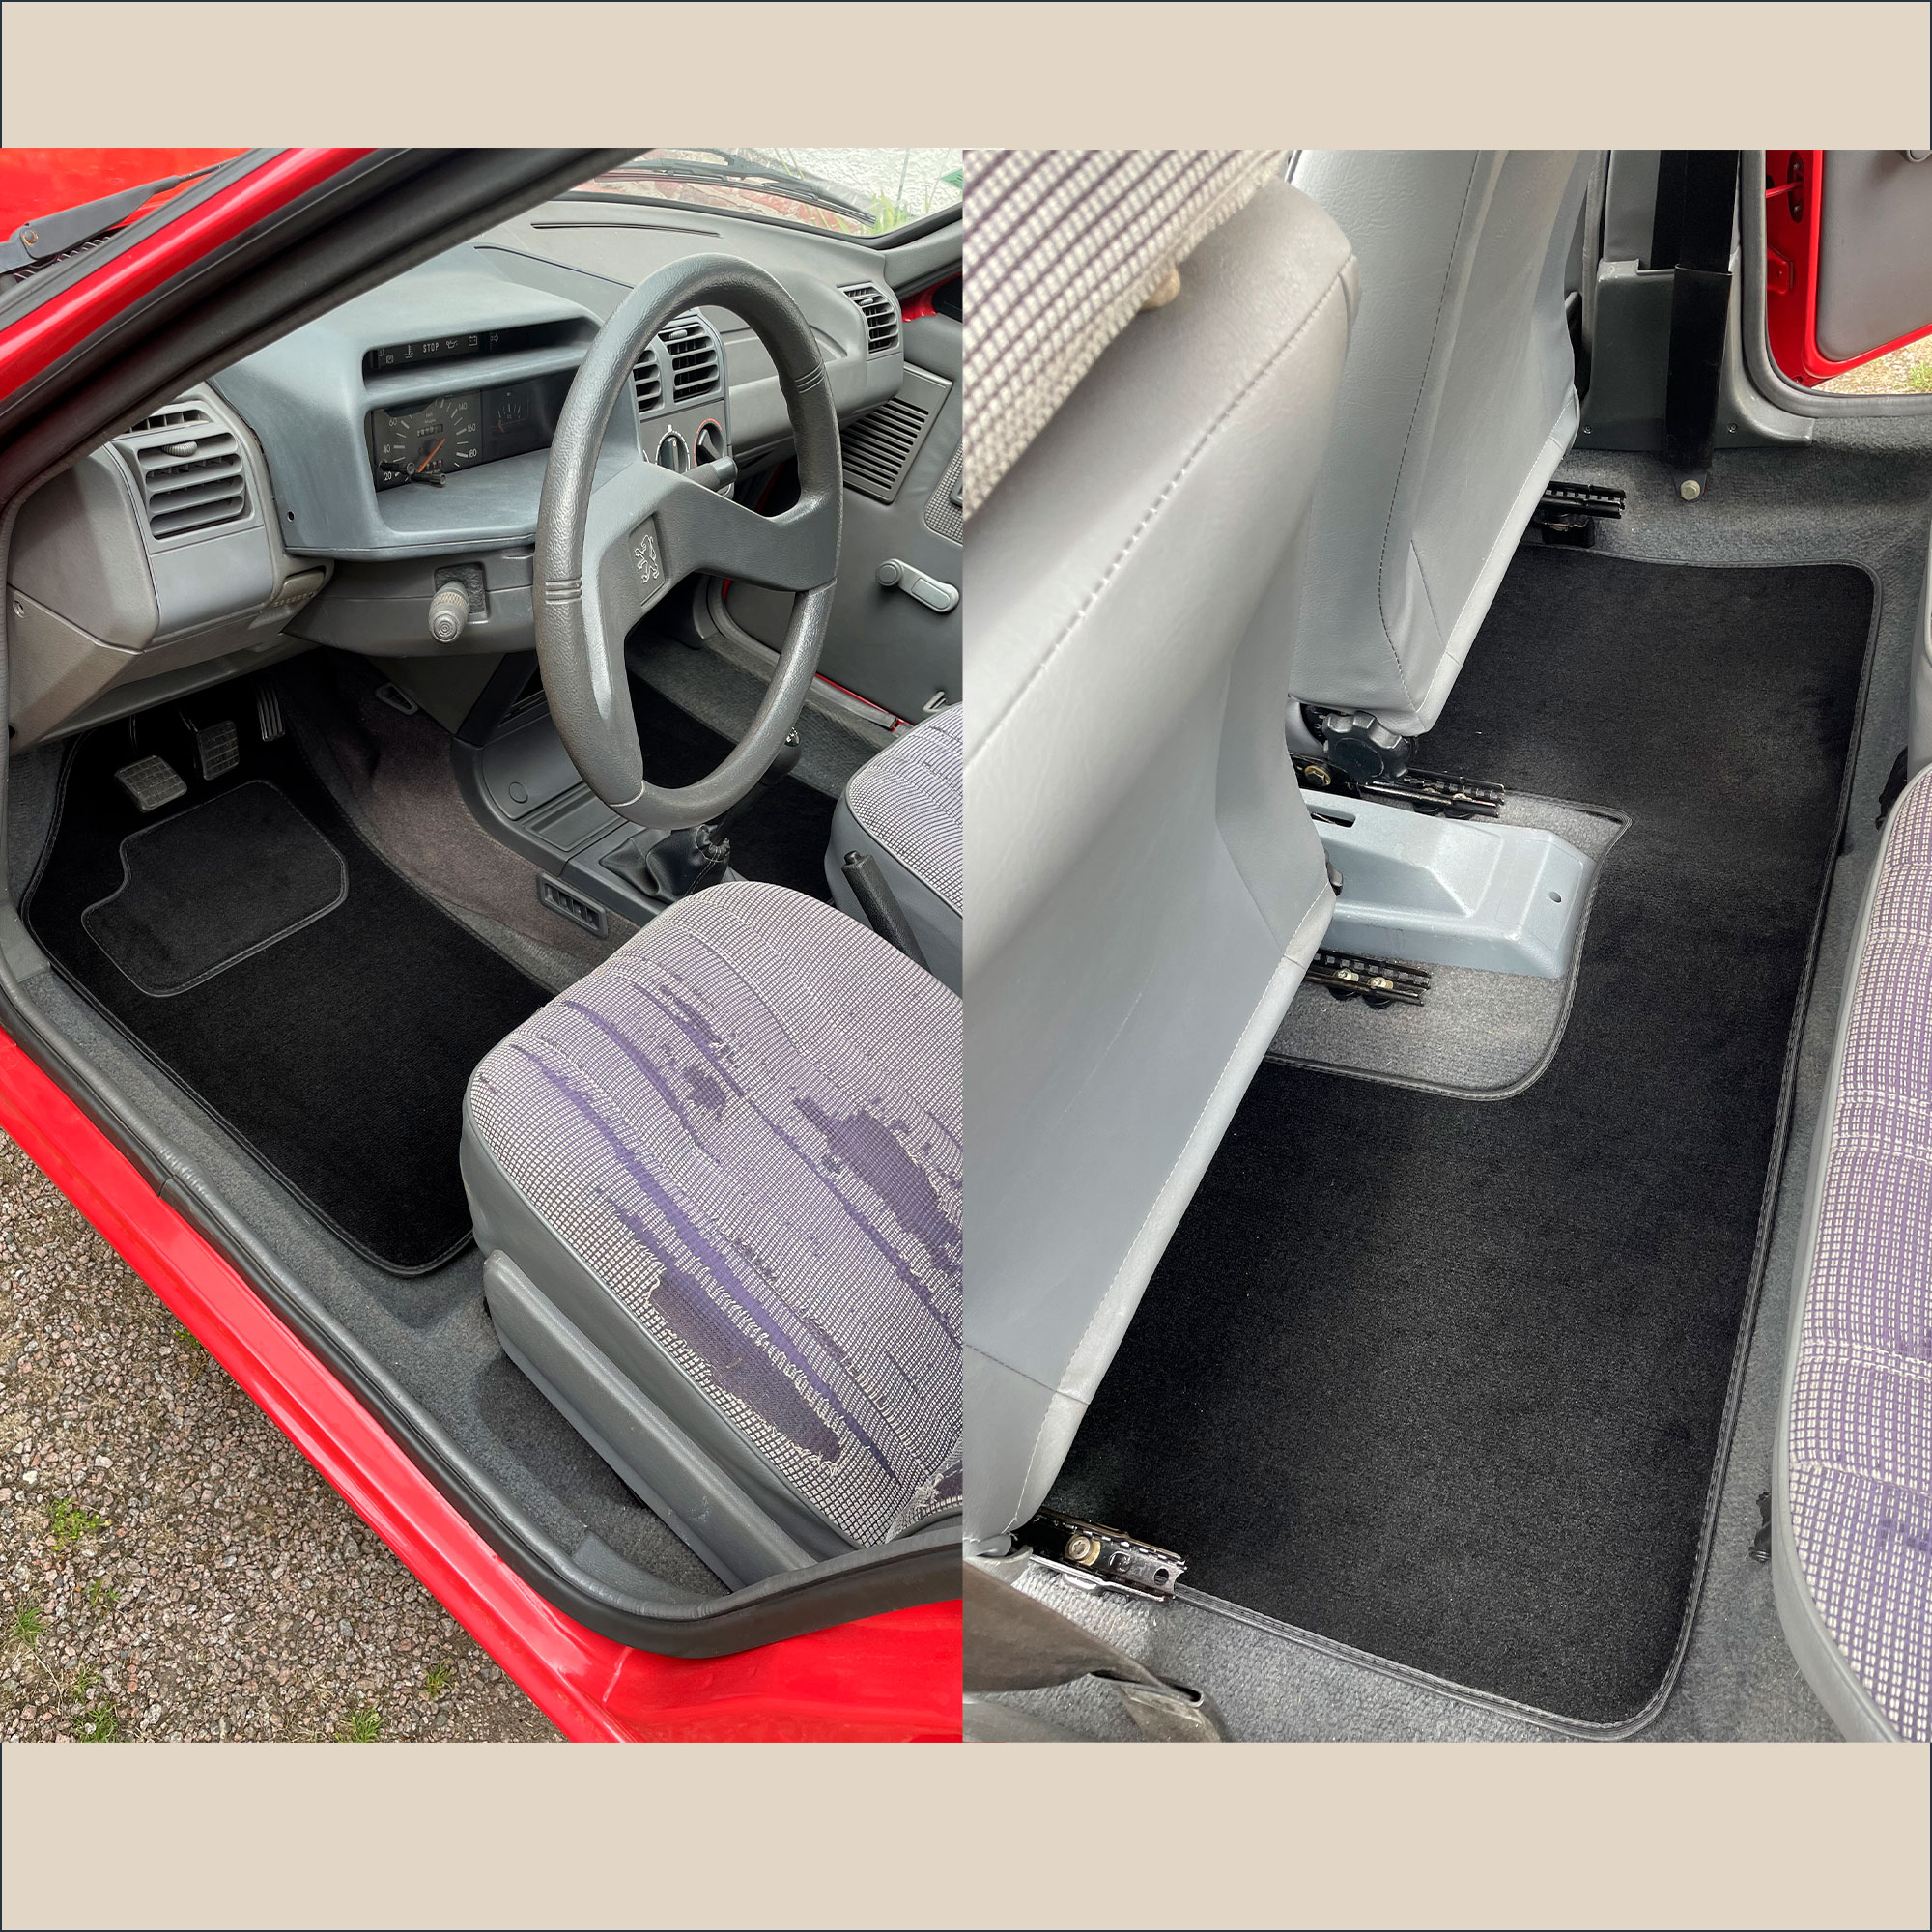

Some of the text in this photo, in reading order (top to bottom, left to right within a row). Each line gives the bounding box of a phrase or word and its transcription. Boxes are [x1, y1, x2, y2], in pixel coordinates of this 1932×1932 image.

[423, 342, 440, 354] STOP
[459, 402, 468, 411] 140
[388, 417, 397, 427] 60
[468, 423, 476, 433] 160
[383, 444, 391, 453] 40
[469, 448, 477, 458] 180
[384, 471, 392, 481] 20
